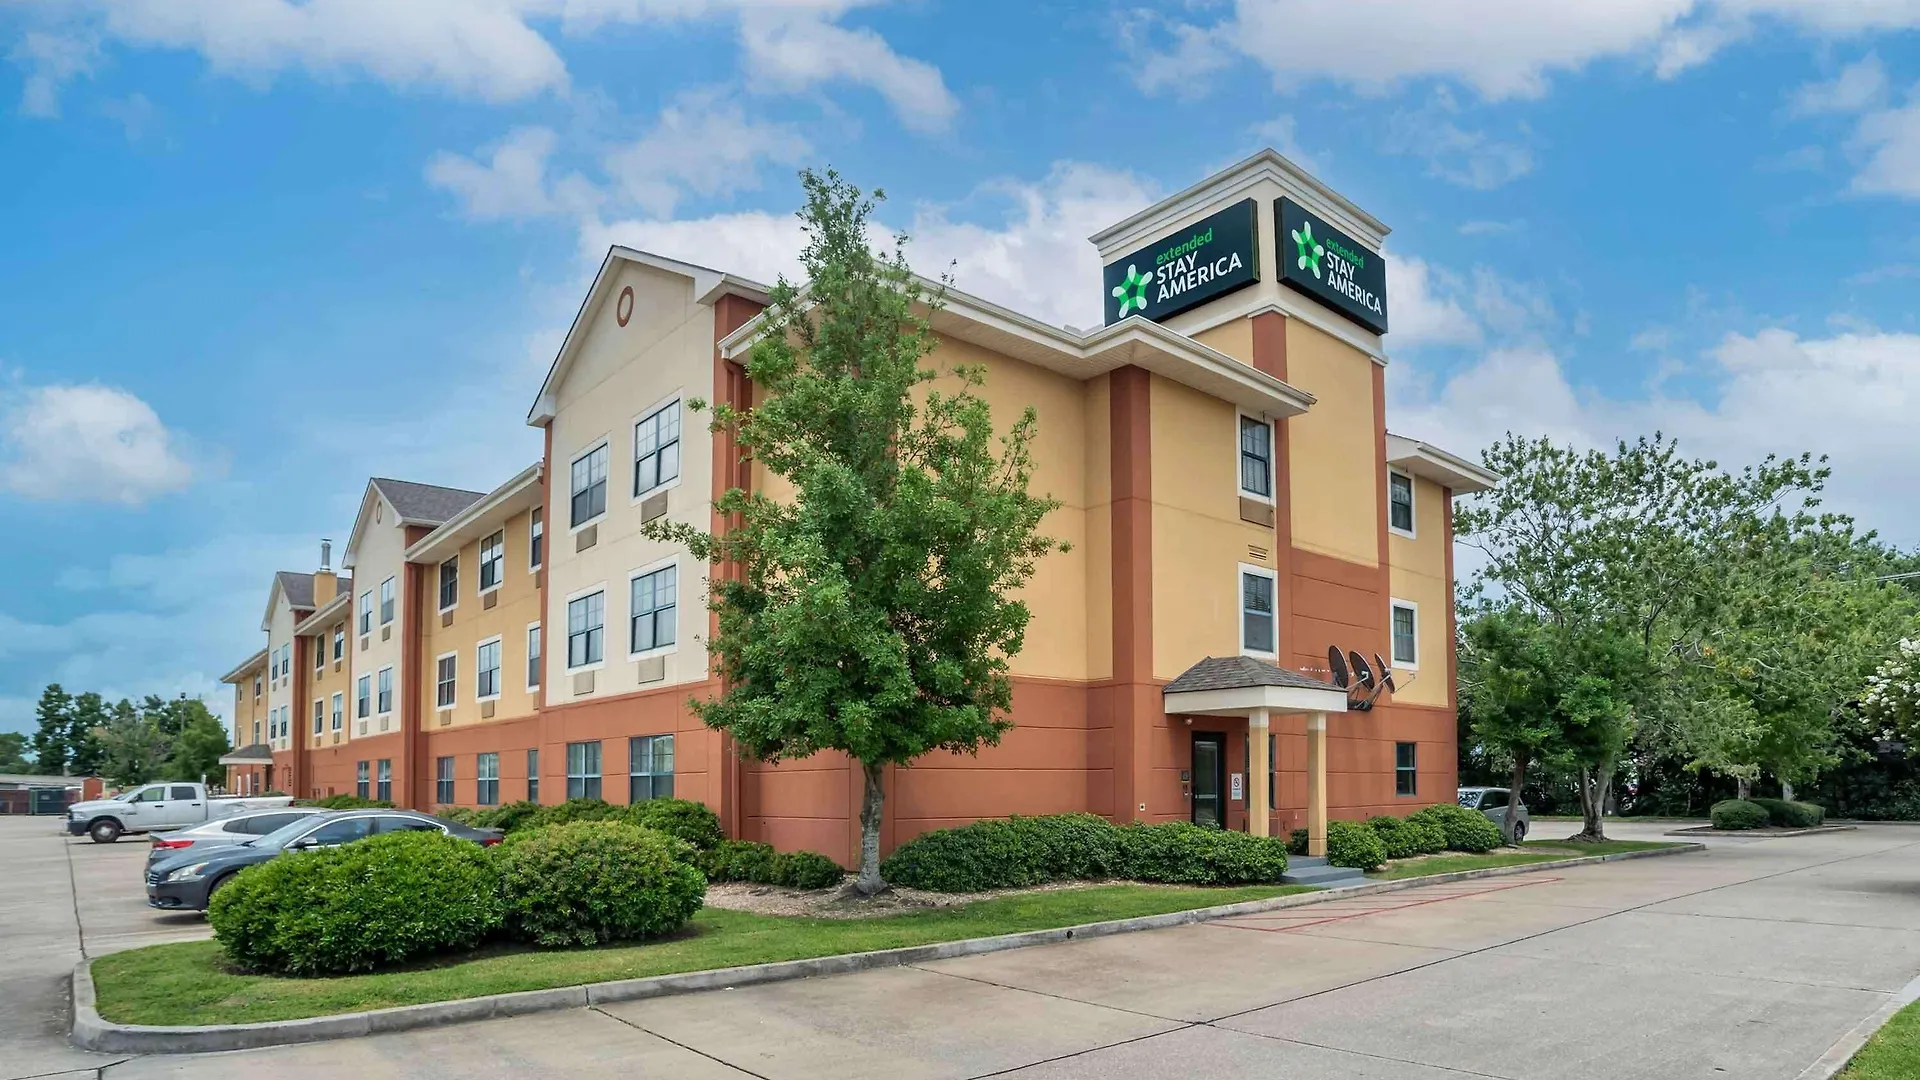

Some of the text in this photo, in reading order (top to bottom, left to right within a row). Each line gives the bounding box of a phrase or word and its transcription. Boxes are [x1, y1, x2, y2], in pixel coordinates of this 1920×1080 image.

[1156, 228, 1213, 265] extended
[1326, 238, 1364, 269] extended
[1156, 251, 1198, 285] STAY
[1157, 252, 1243, 303] AMERICA
[1326, 251, 1356, 281] STAY
[1327, 274, 1382, 316] AMERICA
